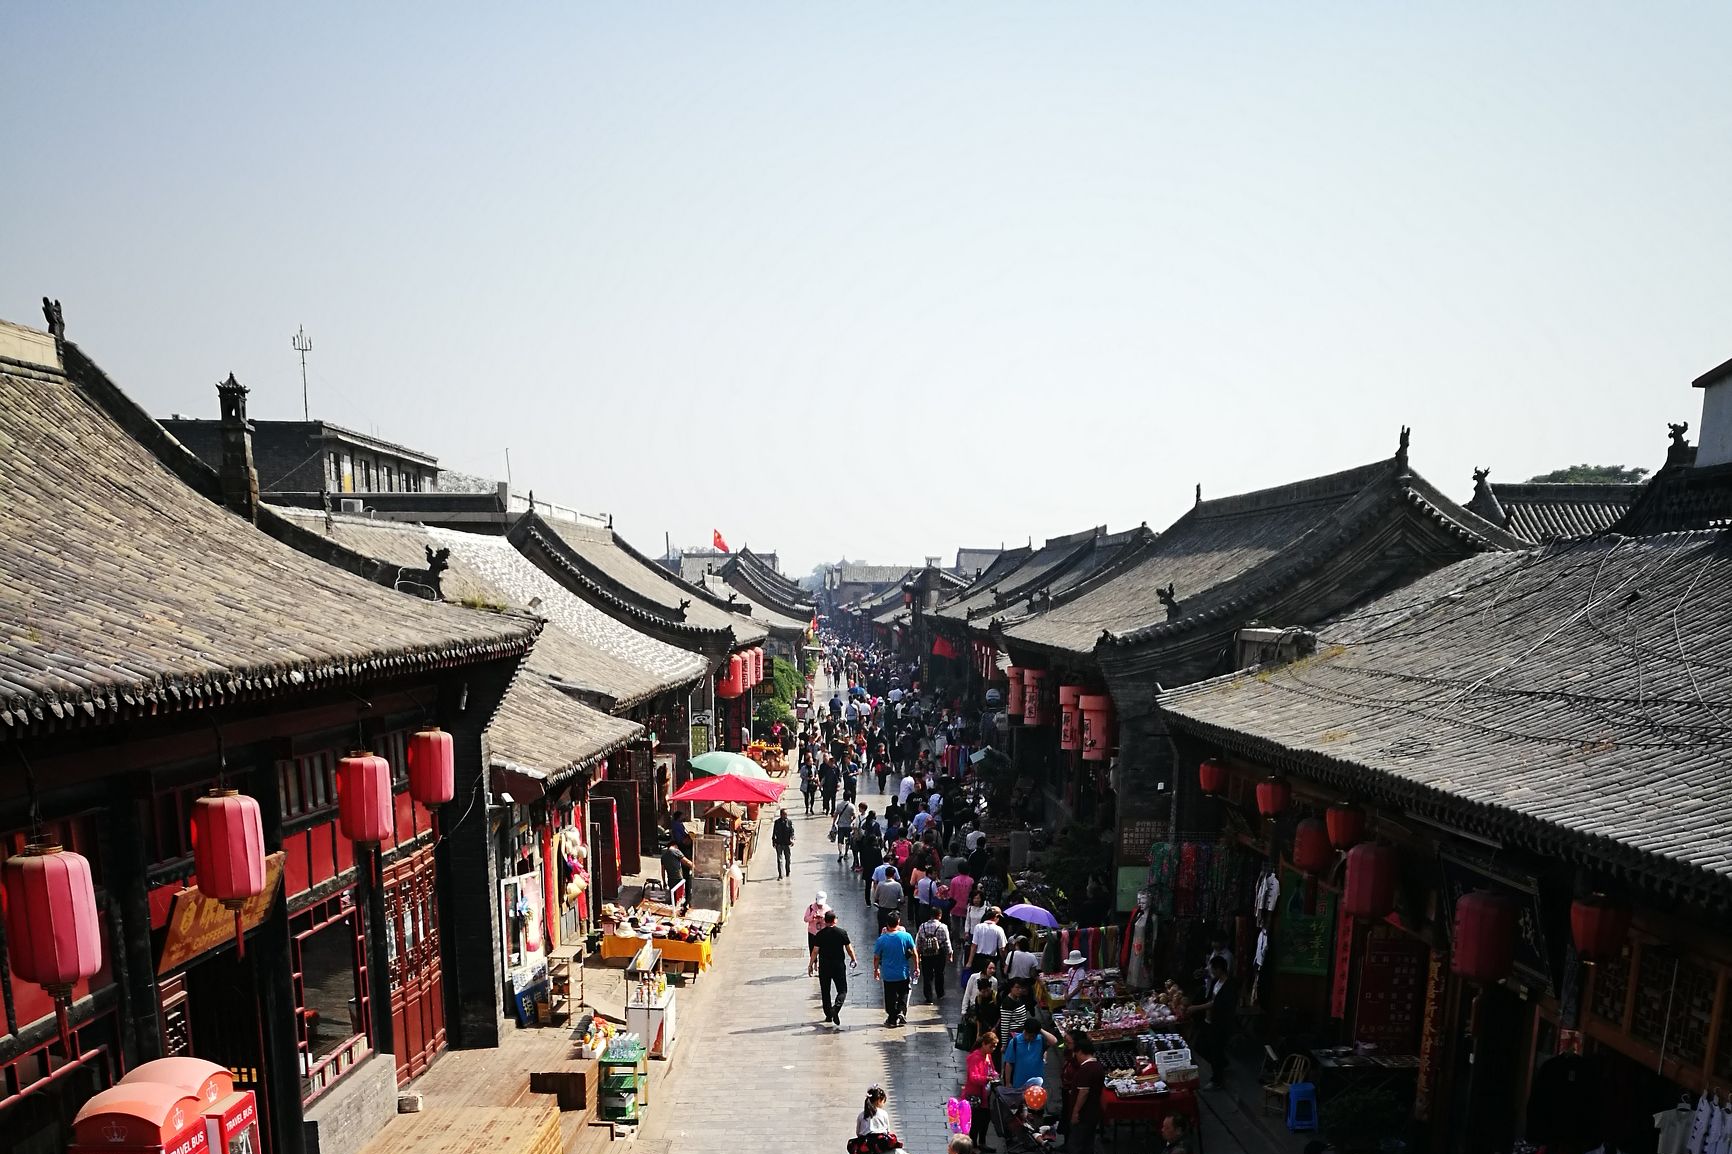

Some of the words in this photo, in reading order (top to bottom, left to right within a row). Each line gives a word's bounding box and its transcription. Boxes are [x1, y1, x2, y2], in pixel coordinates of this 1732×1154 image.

[226, 1115, 244, 1132] TRAVEL
[244, 1105, 253, 1118] BUS
[191, 1130, 205, 1149] BUS
